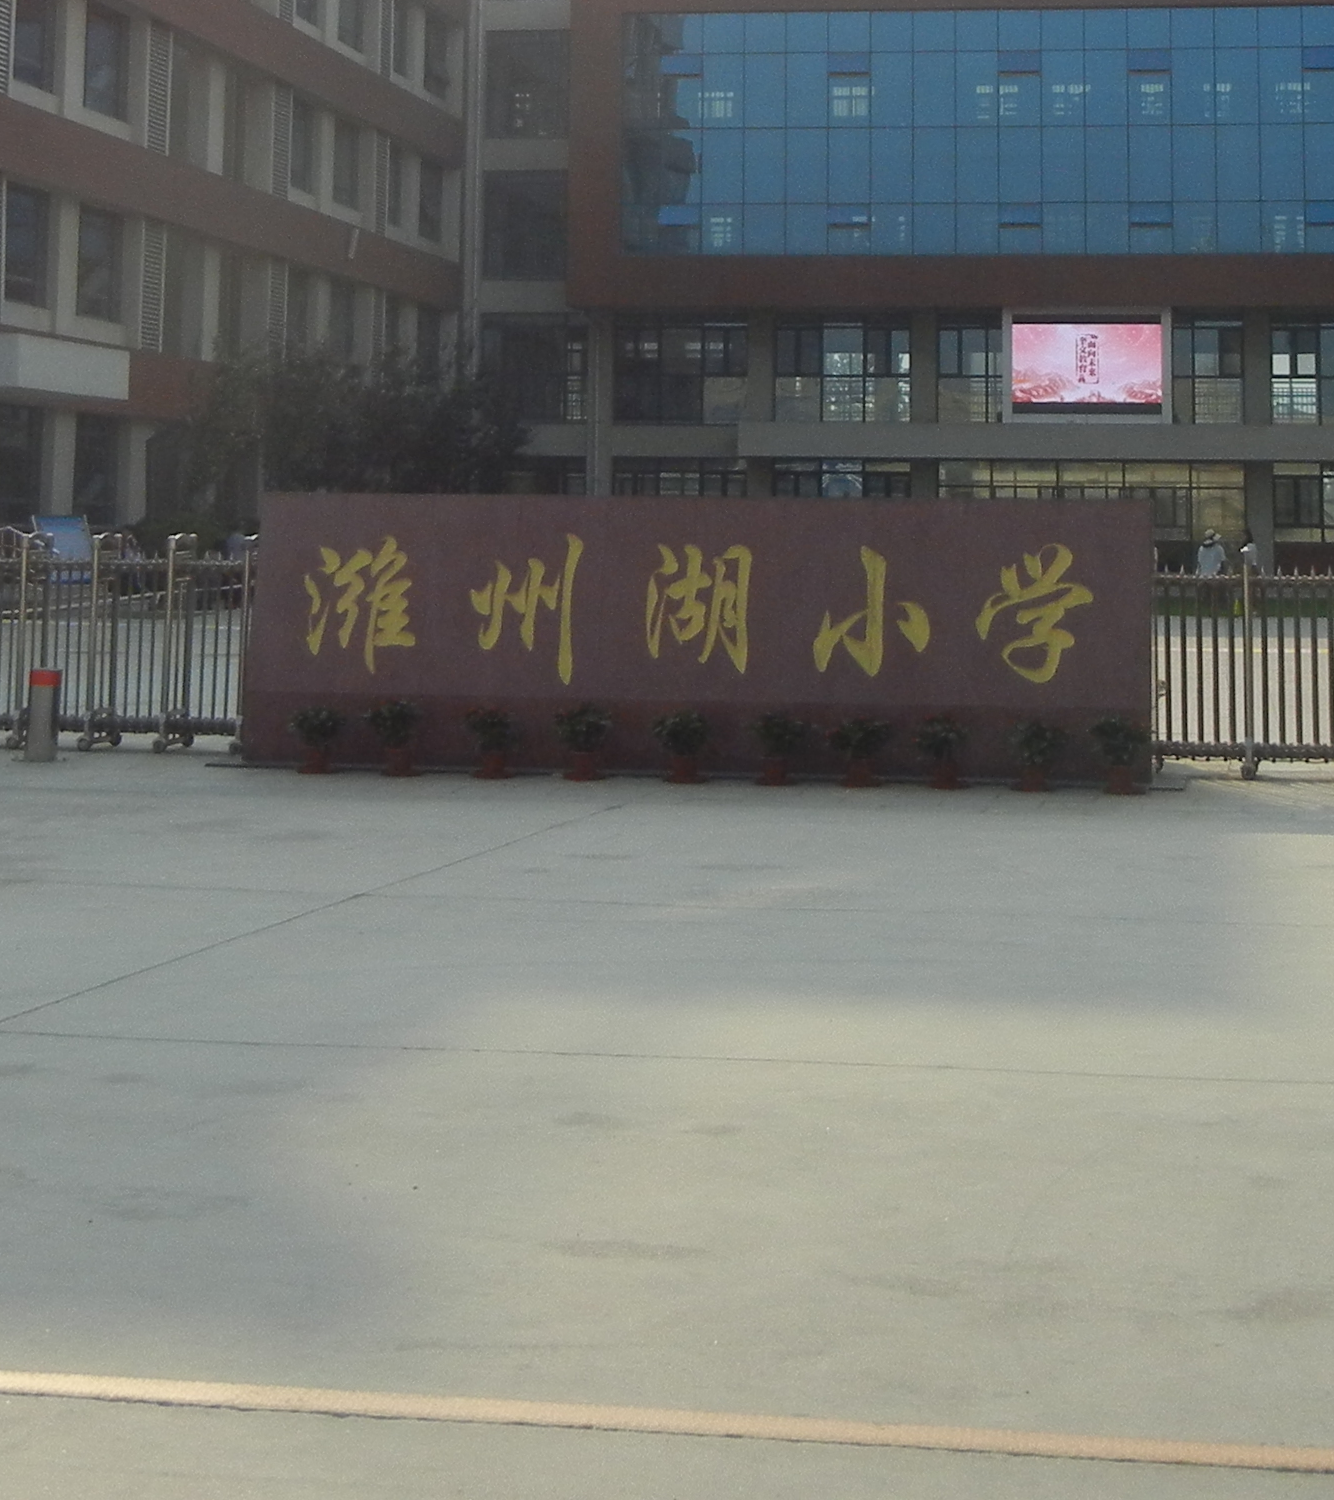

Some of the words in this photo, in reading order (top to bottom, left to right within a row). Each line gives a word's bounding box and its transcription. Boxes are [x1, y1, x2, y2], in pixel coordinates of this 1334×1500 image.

[1087, 341, 1097, 377] 面向未来
[304, 534, 1094, 685] 潍州湖小学
